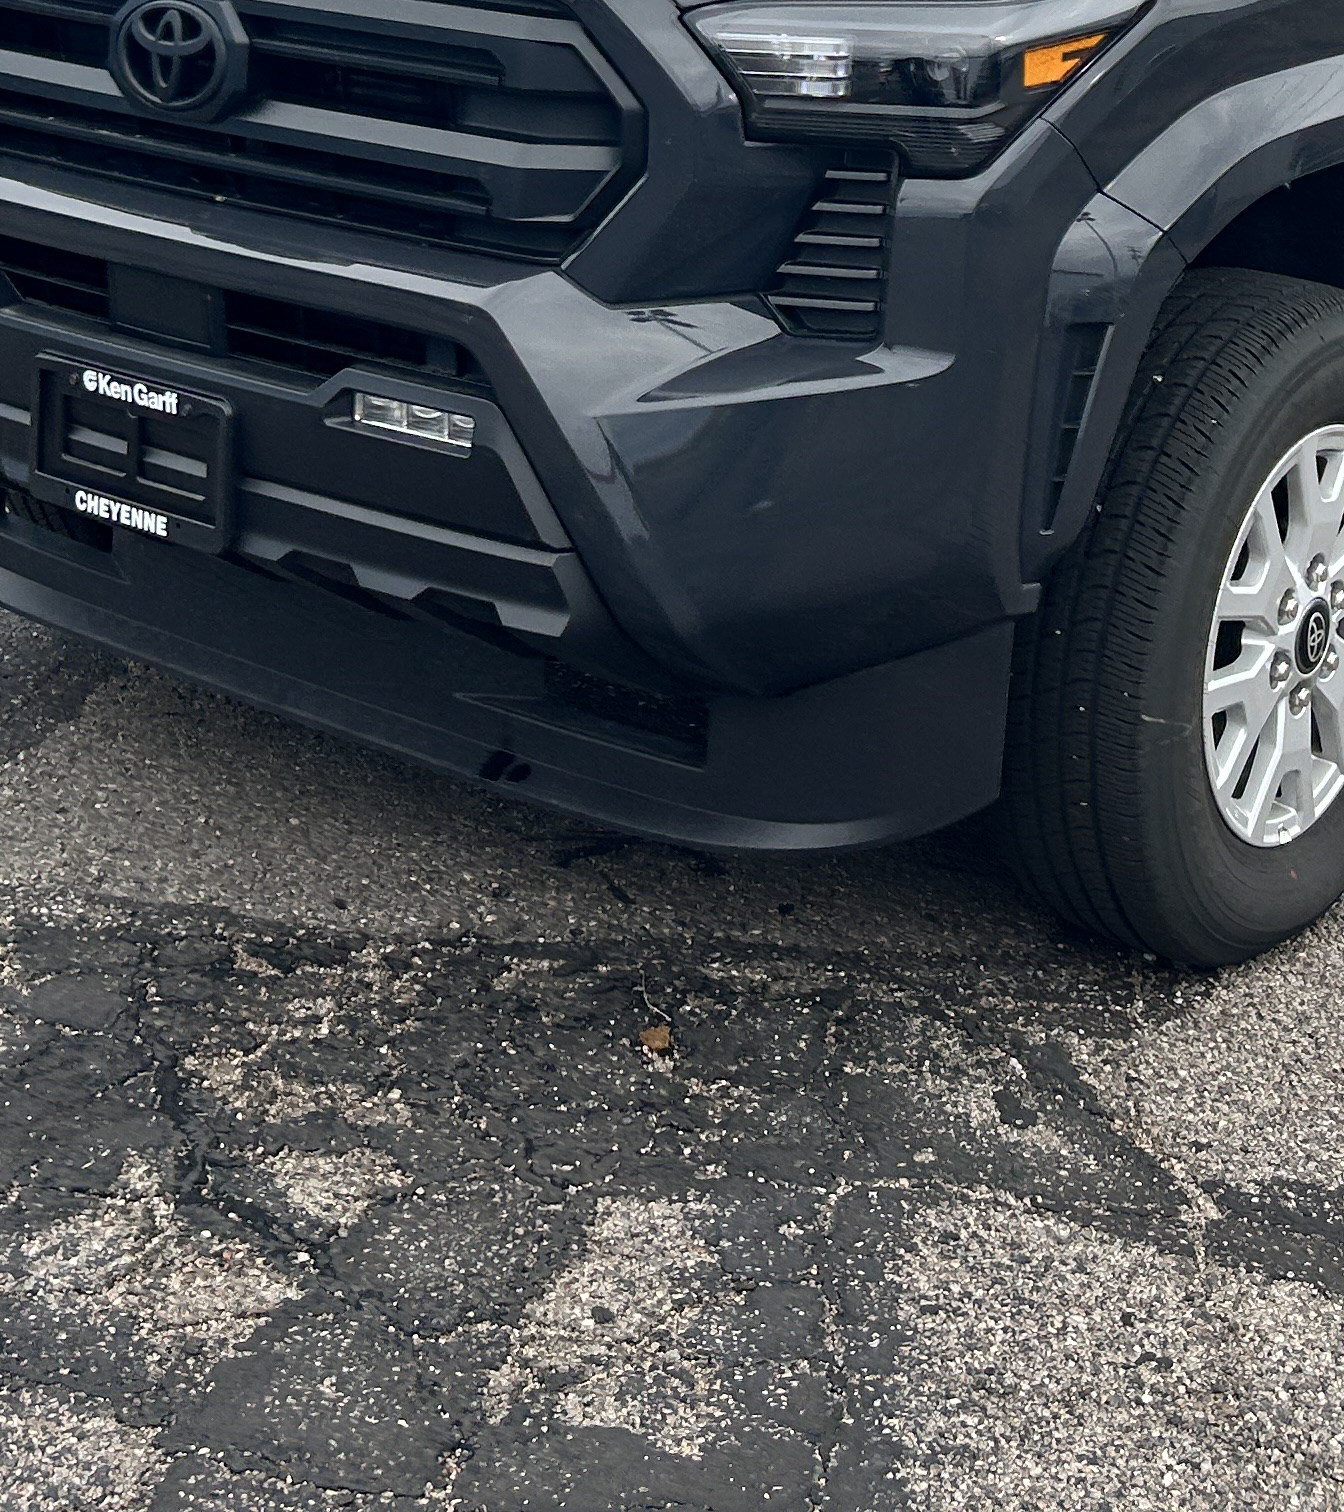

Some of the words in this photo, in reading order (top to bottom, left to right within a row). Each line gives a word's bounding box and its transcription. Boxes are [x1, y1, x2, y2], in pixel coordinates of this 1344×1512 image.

[98, 373, 133, 402] Ken
[133, 383, 178, 414] Garff
[75, 490, 168, 536] CHEYENNE
